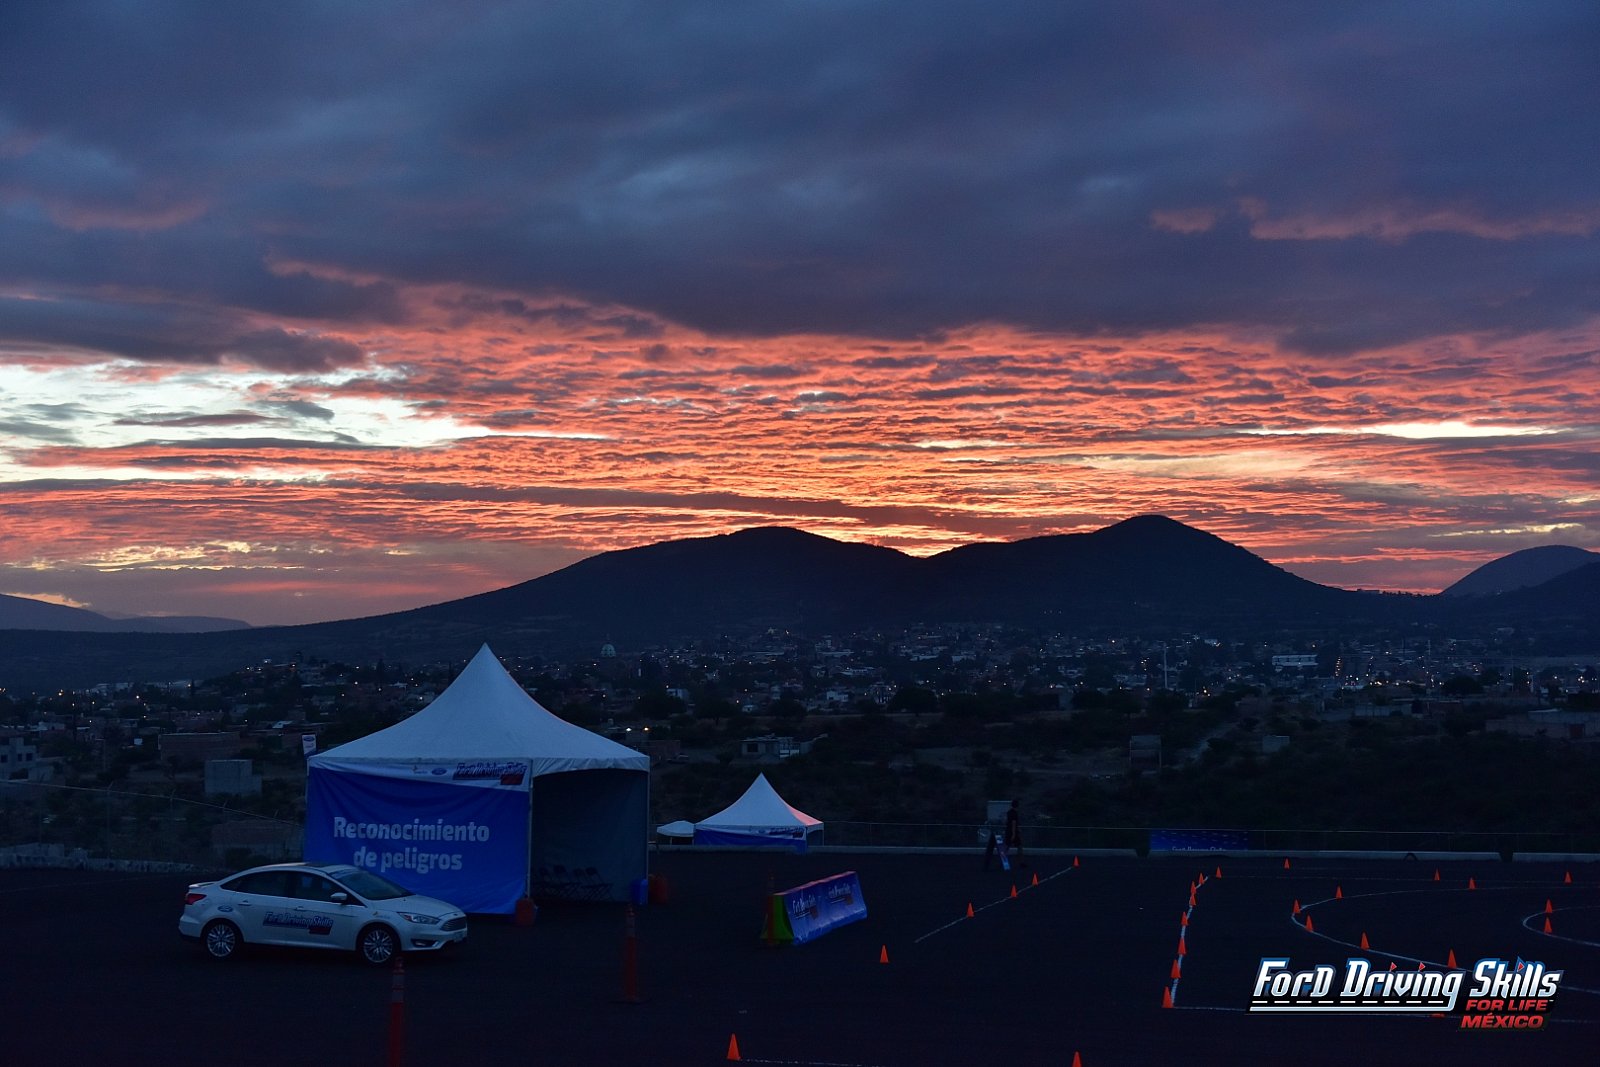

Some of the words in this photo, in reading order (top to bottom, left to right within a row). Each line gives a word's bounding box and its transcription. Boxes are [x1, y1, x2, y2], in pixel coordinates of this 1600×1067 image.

[333, 816, 490, 842] Reconocimiento
[353, 846, 378, 868] de
[381, 847, 463, 875] peligros
